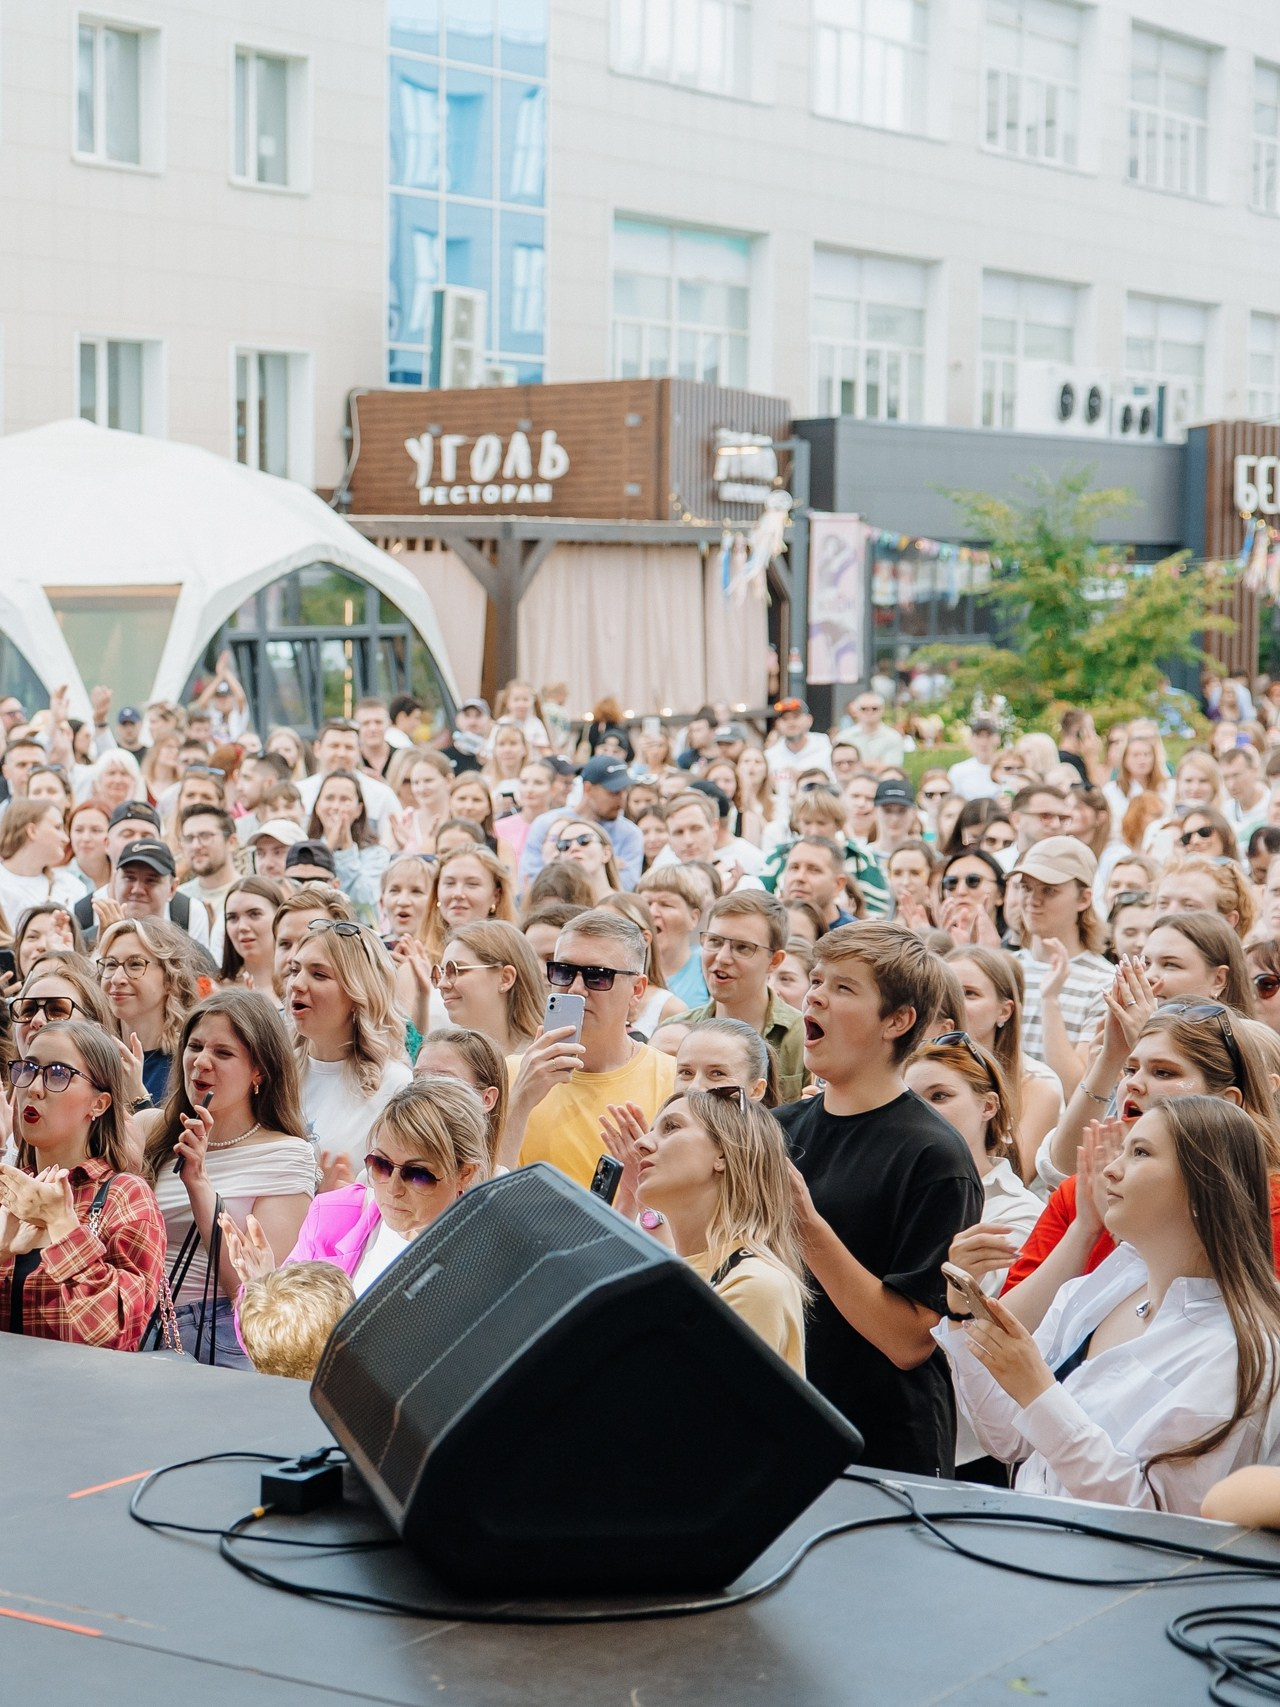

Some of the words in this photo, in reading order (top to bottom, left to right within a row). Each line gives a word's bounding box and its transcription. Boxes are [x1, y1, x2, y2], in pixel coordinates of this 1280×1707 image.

[404, 430, 570, 490] УГОЛЬ
[1234, 455, 1280, 515] БЕ
[419, 483, 553, 506] РЕСТОРАН
